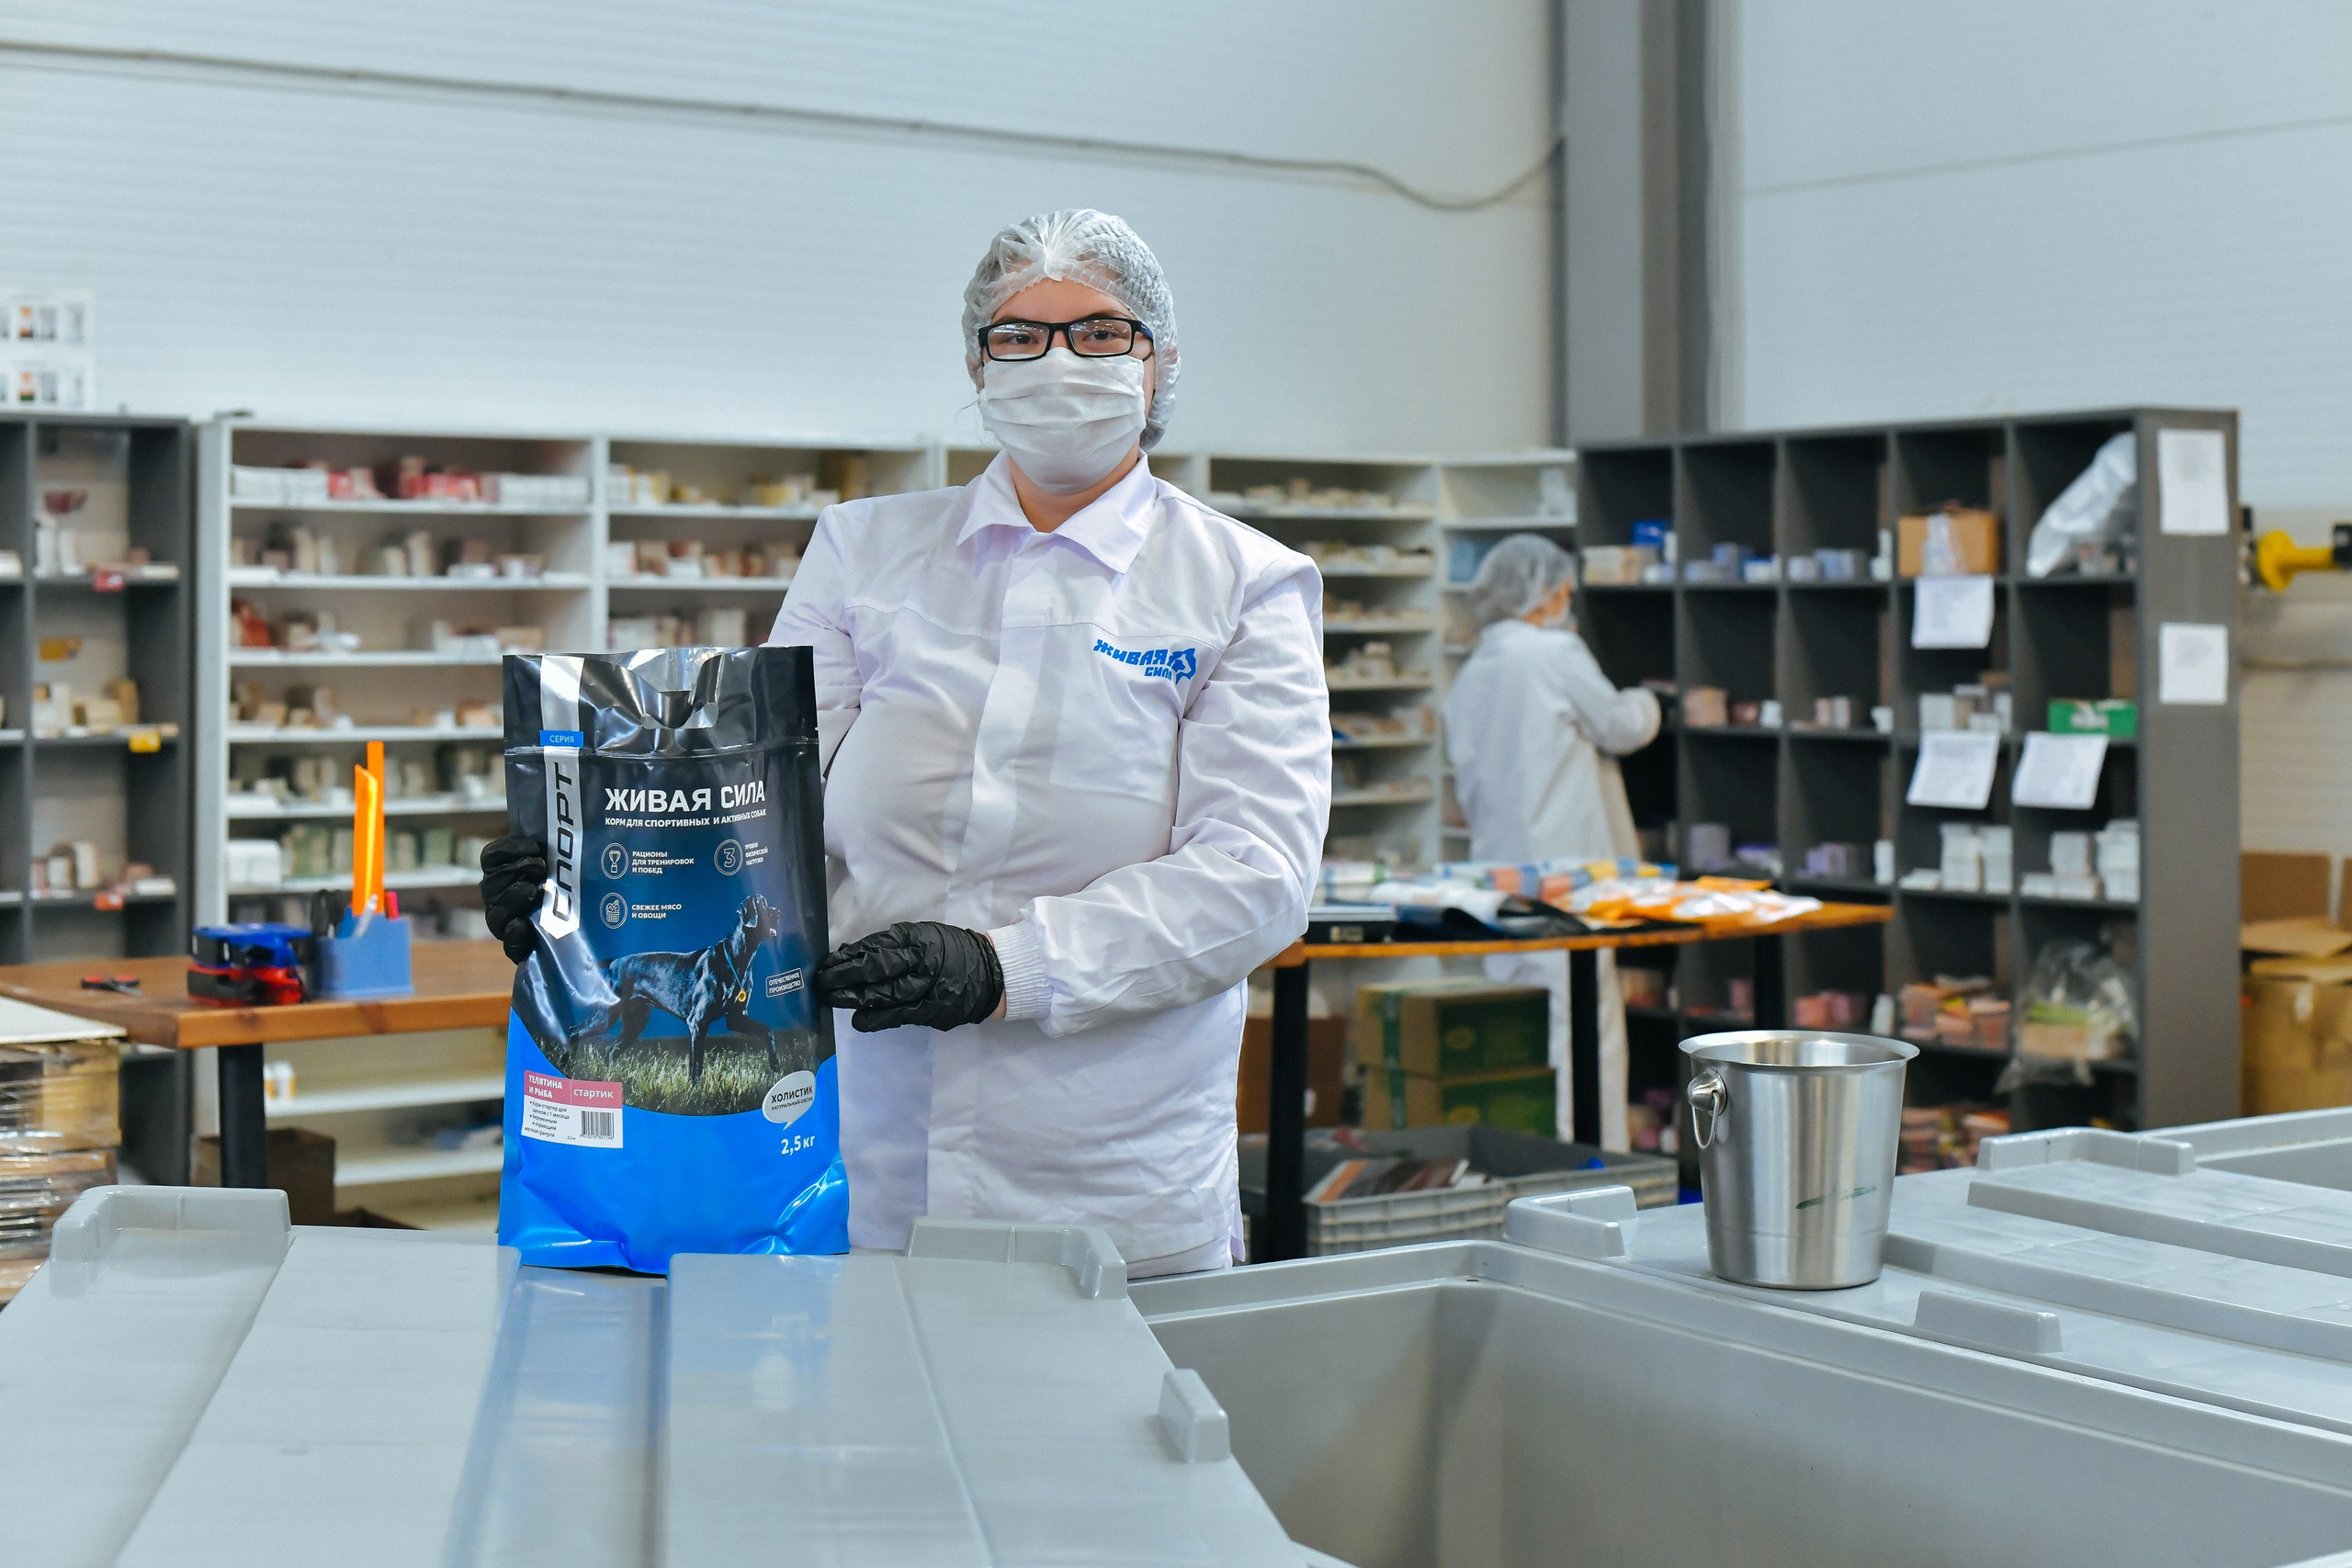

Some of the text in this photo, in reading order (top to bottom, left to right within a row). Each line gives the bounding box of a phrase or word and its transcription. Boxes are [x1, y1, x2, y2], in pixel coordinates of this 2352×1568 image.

[1093, 639, 1168, 665] ЖИВАЯ
[1145, 667, 1171, 681] СИЛА
[549, 735, 575, 743] СЕРИЯ
[605, 780, 766, 813] ЖИВАЯ СИЛА
[605, 808, 767, 828] КОРМ ДЛЯ СПОРТИВНЫХ И АКТИВНЫХ СОБАК
[553, 761, 574, 921] СПОРТ
[632, 851, 668, 859] РАЦИОНЫ
[661, 903, 682, 911] МЯСО
[768, 972, 800, 987] ОТЕЧЕСТВЕННОЕ
[769, 980, 801, 994] ПРОИЗВОДСТВО
[528, 1075, 563, 1089] ТЕЛЯТИНА
[534, 1088, 553, 1099] РЫБА
[573, 1089, 614, 1100] стартик
[771, 1085, 814, 1104] ХОЛИСТИК
[771, 1100, 800, 1111] НАТУРАЛЬНЫЙ
[780, 1134, 816, 1156] 2,5 кг
